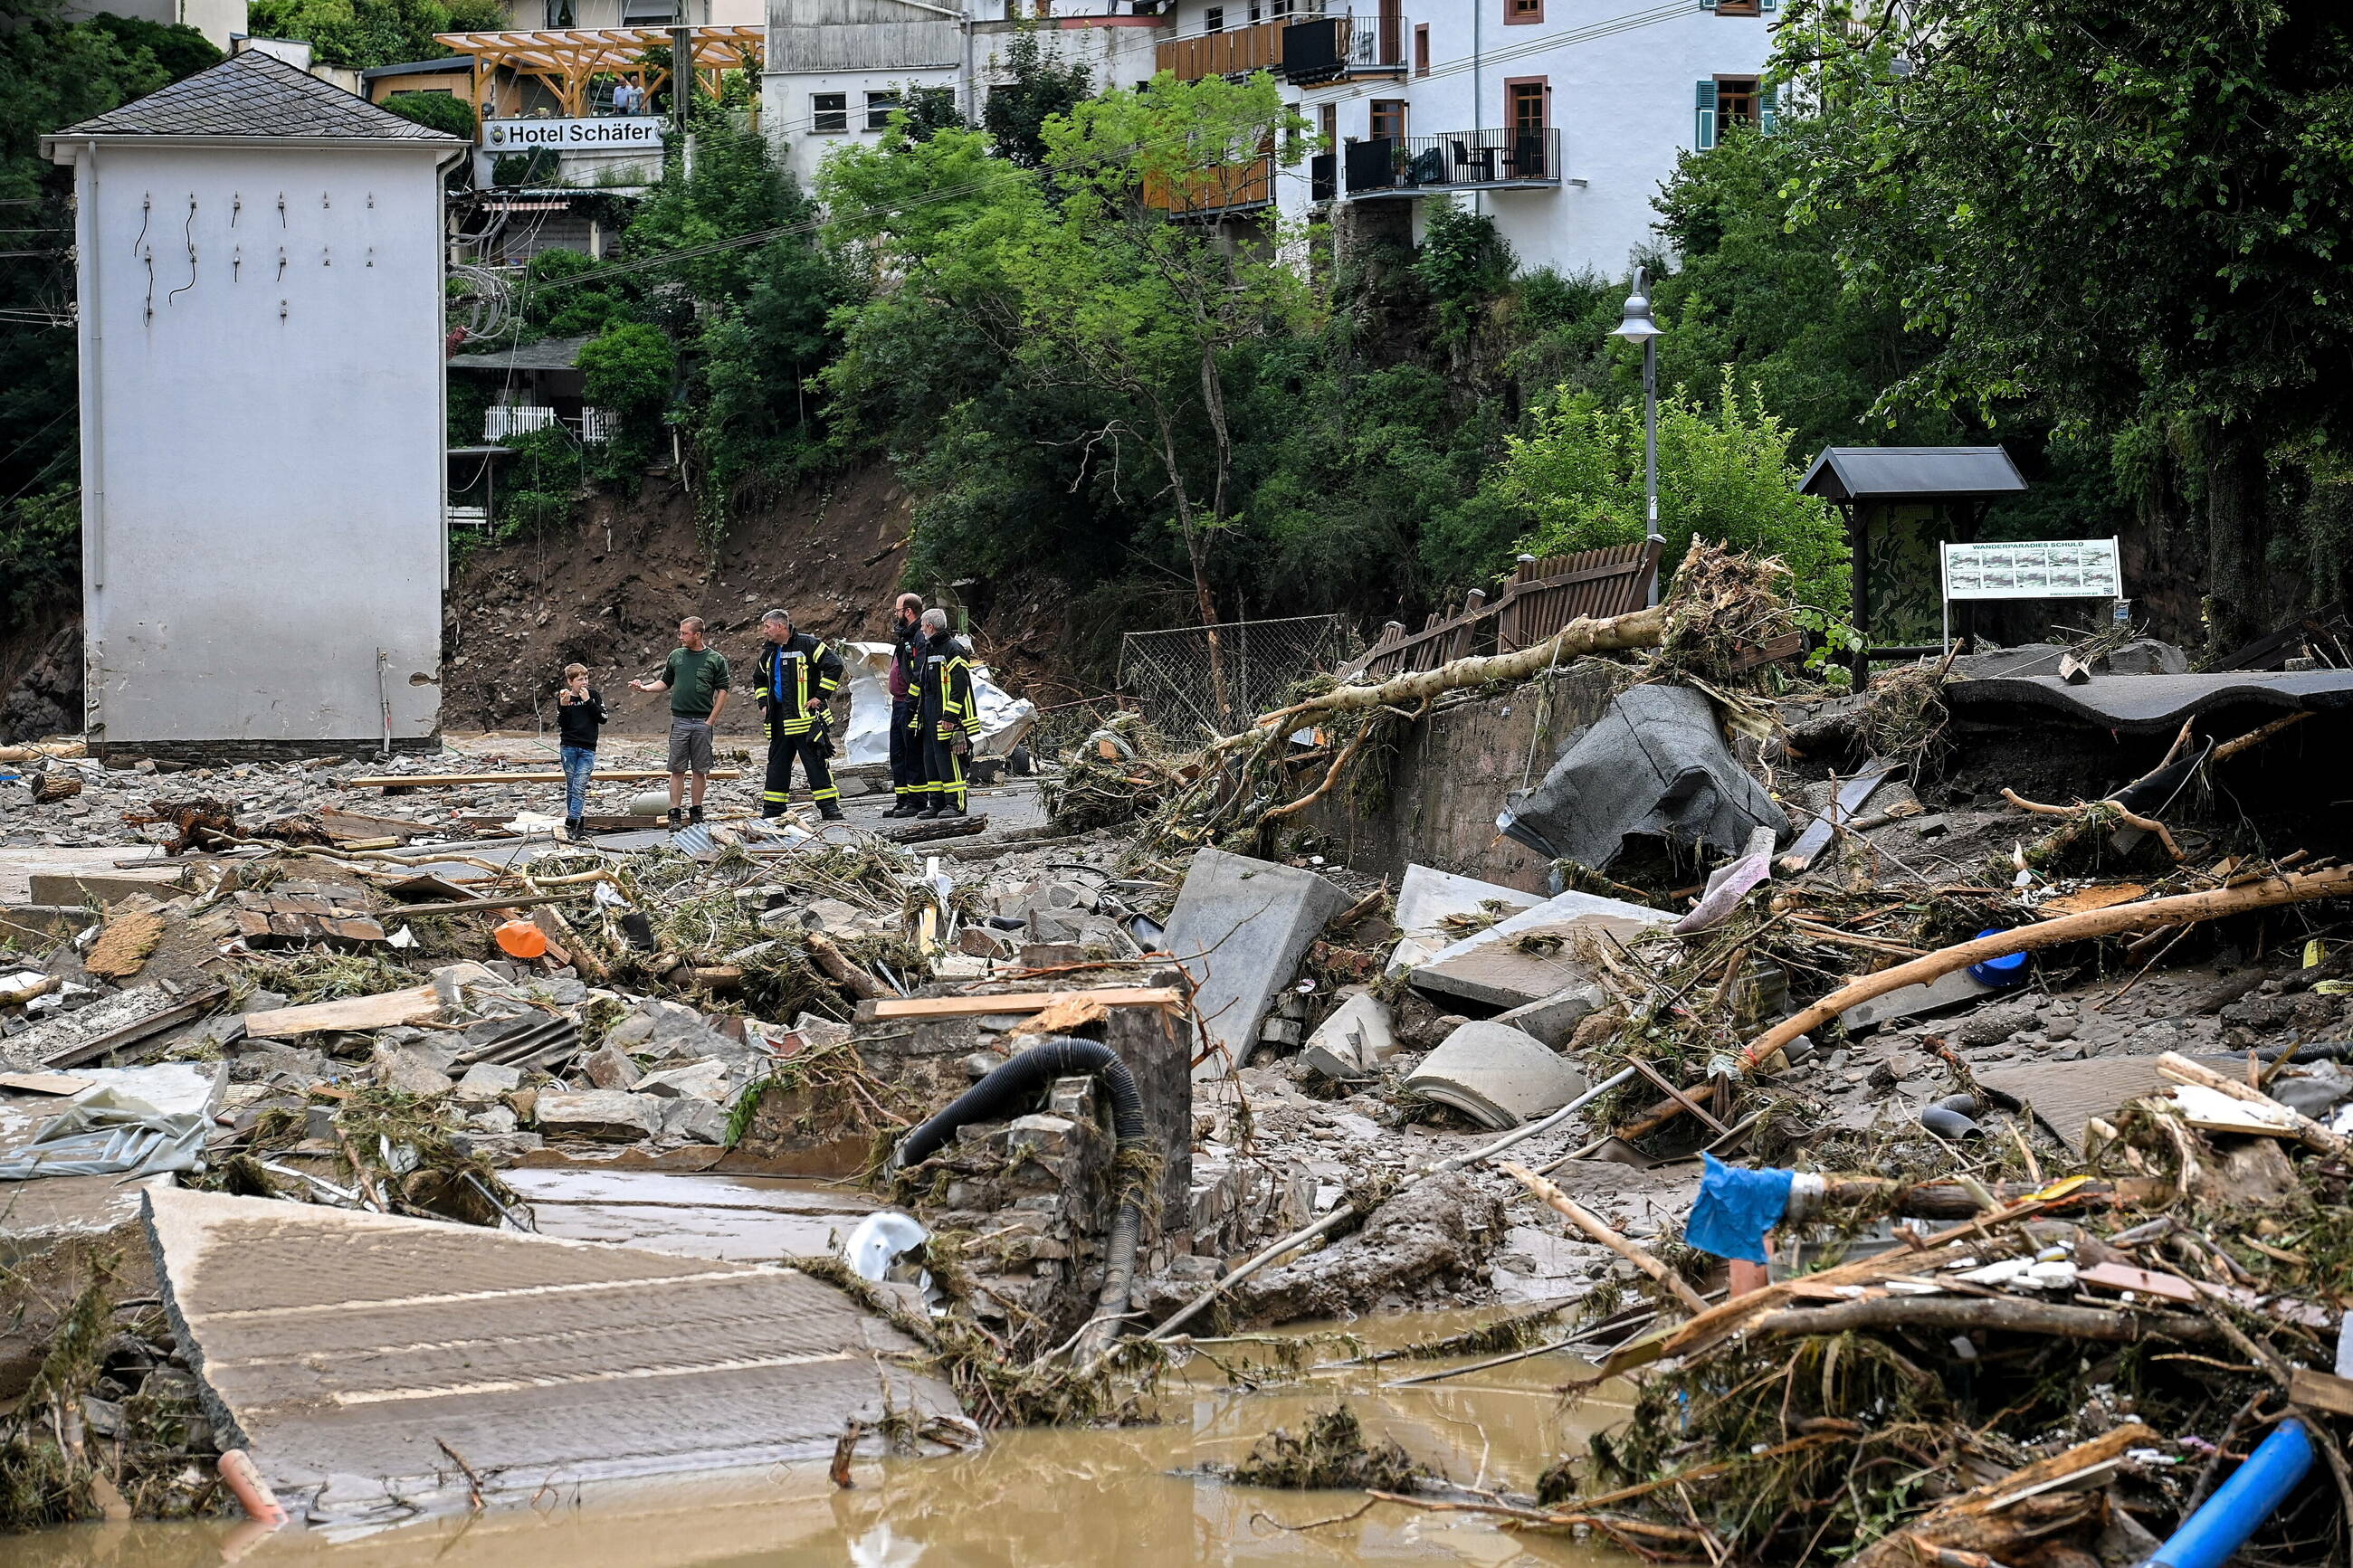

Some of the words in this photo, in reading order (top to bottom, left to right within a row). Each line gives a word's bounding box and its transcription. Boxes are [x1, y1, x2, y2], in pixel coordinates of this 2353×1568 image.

[510, 125, 563, 142] Hotel
[570, 123, 653, 141] Schäfer
[1972, 542, 2049, 550] WANDERPARADIES
